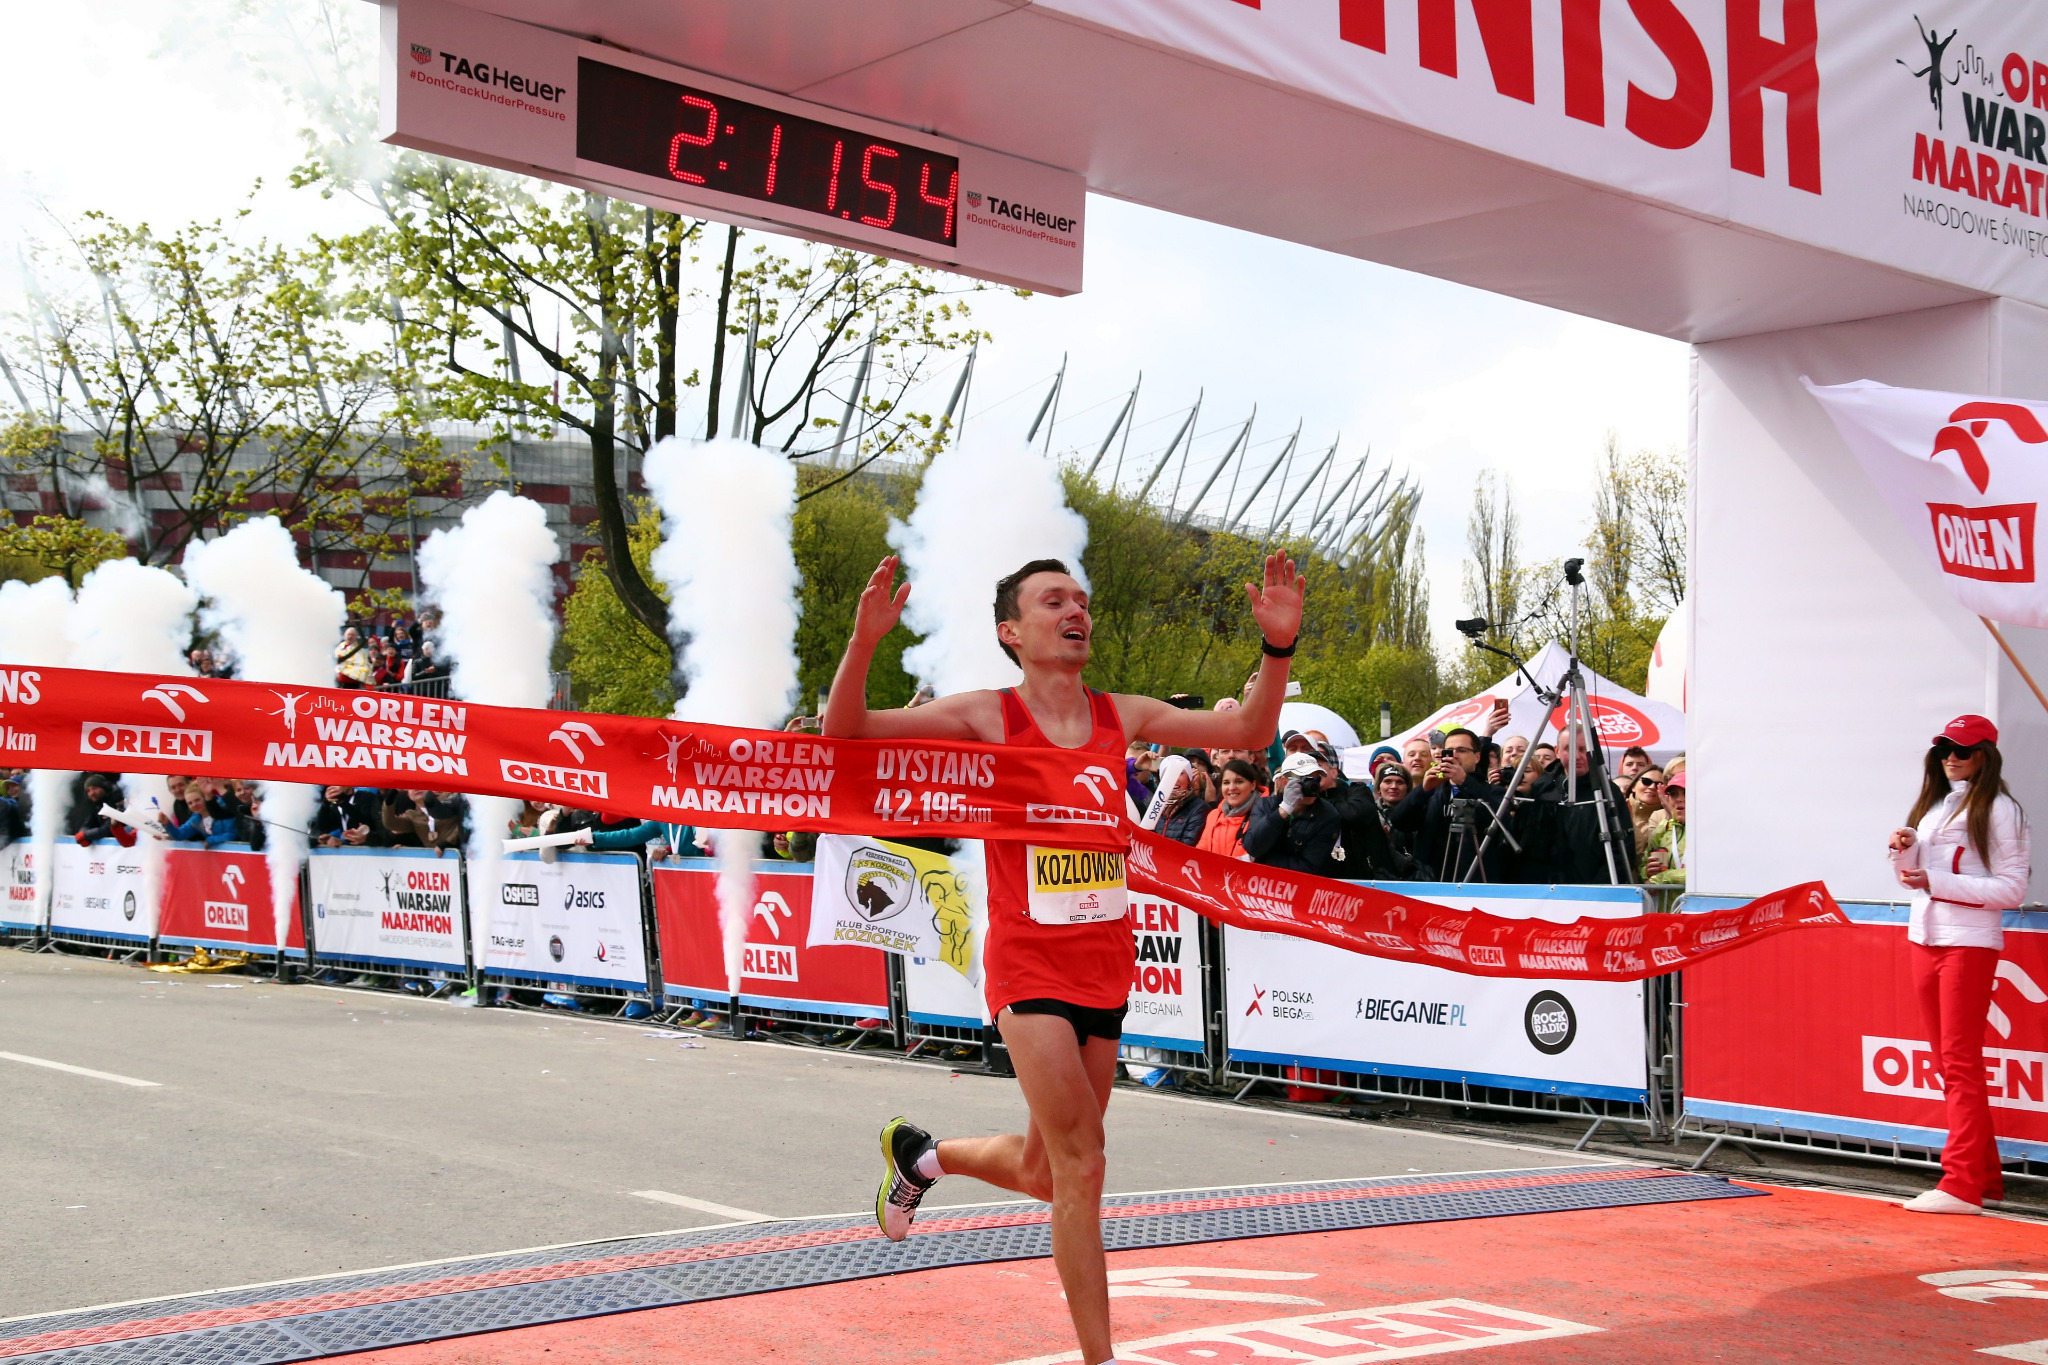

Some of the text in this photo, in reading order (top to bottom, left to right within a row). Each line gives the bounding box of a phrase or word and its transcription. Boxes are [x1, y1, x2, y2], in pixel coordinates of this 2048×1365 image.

[410, 69, 566, 121] #DontCrackUnderPressure
[1962, 91, 2048, 165] WAR
[1904, 193, 1998, 241] NARODOWE
[967, 213, 1076, 248] #DontCrackUnderPressure
[1938, 512, 2024, 570] ORLEN
[351, 696, 466, 731] ORLEN
[88, 726, 203, 757] ORLEN
[314, 716, 468, 756] WARSAW
[263, 742, 468, 776] MARATHON
[729, 738, 835, 766] ORLEN
[506, 763, 601, 794] ORLEN
[694, 762, 836, 792] WARSAW
[876, 748, 996, 788] DYSTANS
[651, 785, 831, 819] MARATHON
[89, 862, 105, 875] ams
[407, 871, 450, 891] ORLEN
[870, 861, 906, 878] KOZIOŁEK
[1036, 852, 1124, 886] KOZLOWSKI
[503, 886, 538, 904] OSHEE
[576, 891, 605, 909] asics
[1248, 876, 1298, 901] ORLEN
[396, 892, 451, 913] WARSAW
[1308, 889, 1364, 922] DYSTANS
[208, 906, 244, 926] ORLEN
[382, 911, 452, 935] MARATHON
[834, 928, 917, 952] KOZIOŁEK
[836, 920, 921, 942] KLUB SPORTOWY
[1472, 948, 1503, 965] ORLEN
[1533, 938, 1588, 955] WARSAW
[1518, 953, 1589, 972] MARATHON
[1135, 1000, 1184, 1017] BIEGANIA
[1272, 990, 1313, 1004] POLSKA
[1273, 1006, 1304, 1020] BIEGA
[1364, 998, 1467, 1027] BIEGANIE.PL
[1533, 1011, 1567, 1025] ROCK
[1534, 1022, 1568, 1035] RADIO
[1873, 1046, 2044, 1103] OREN
